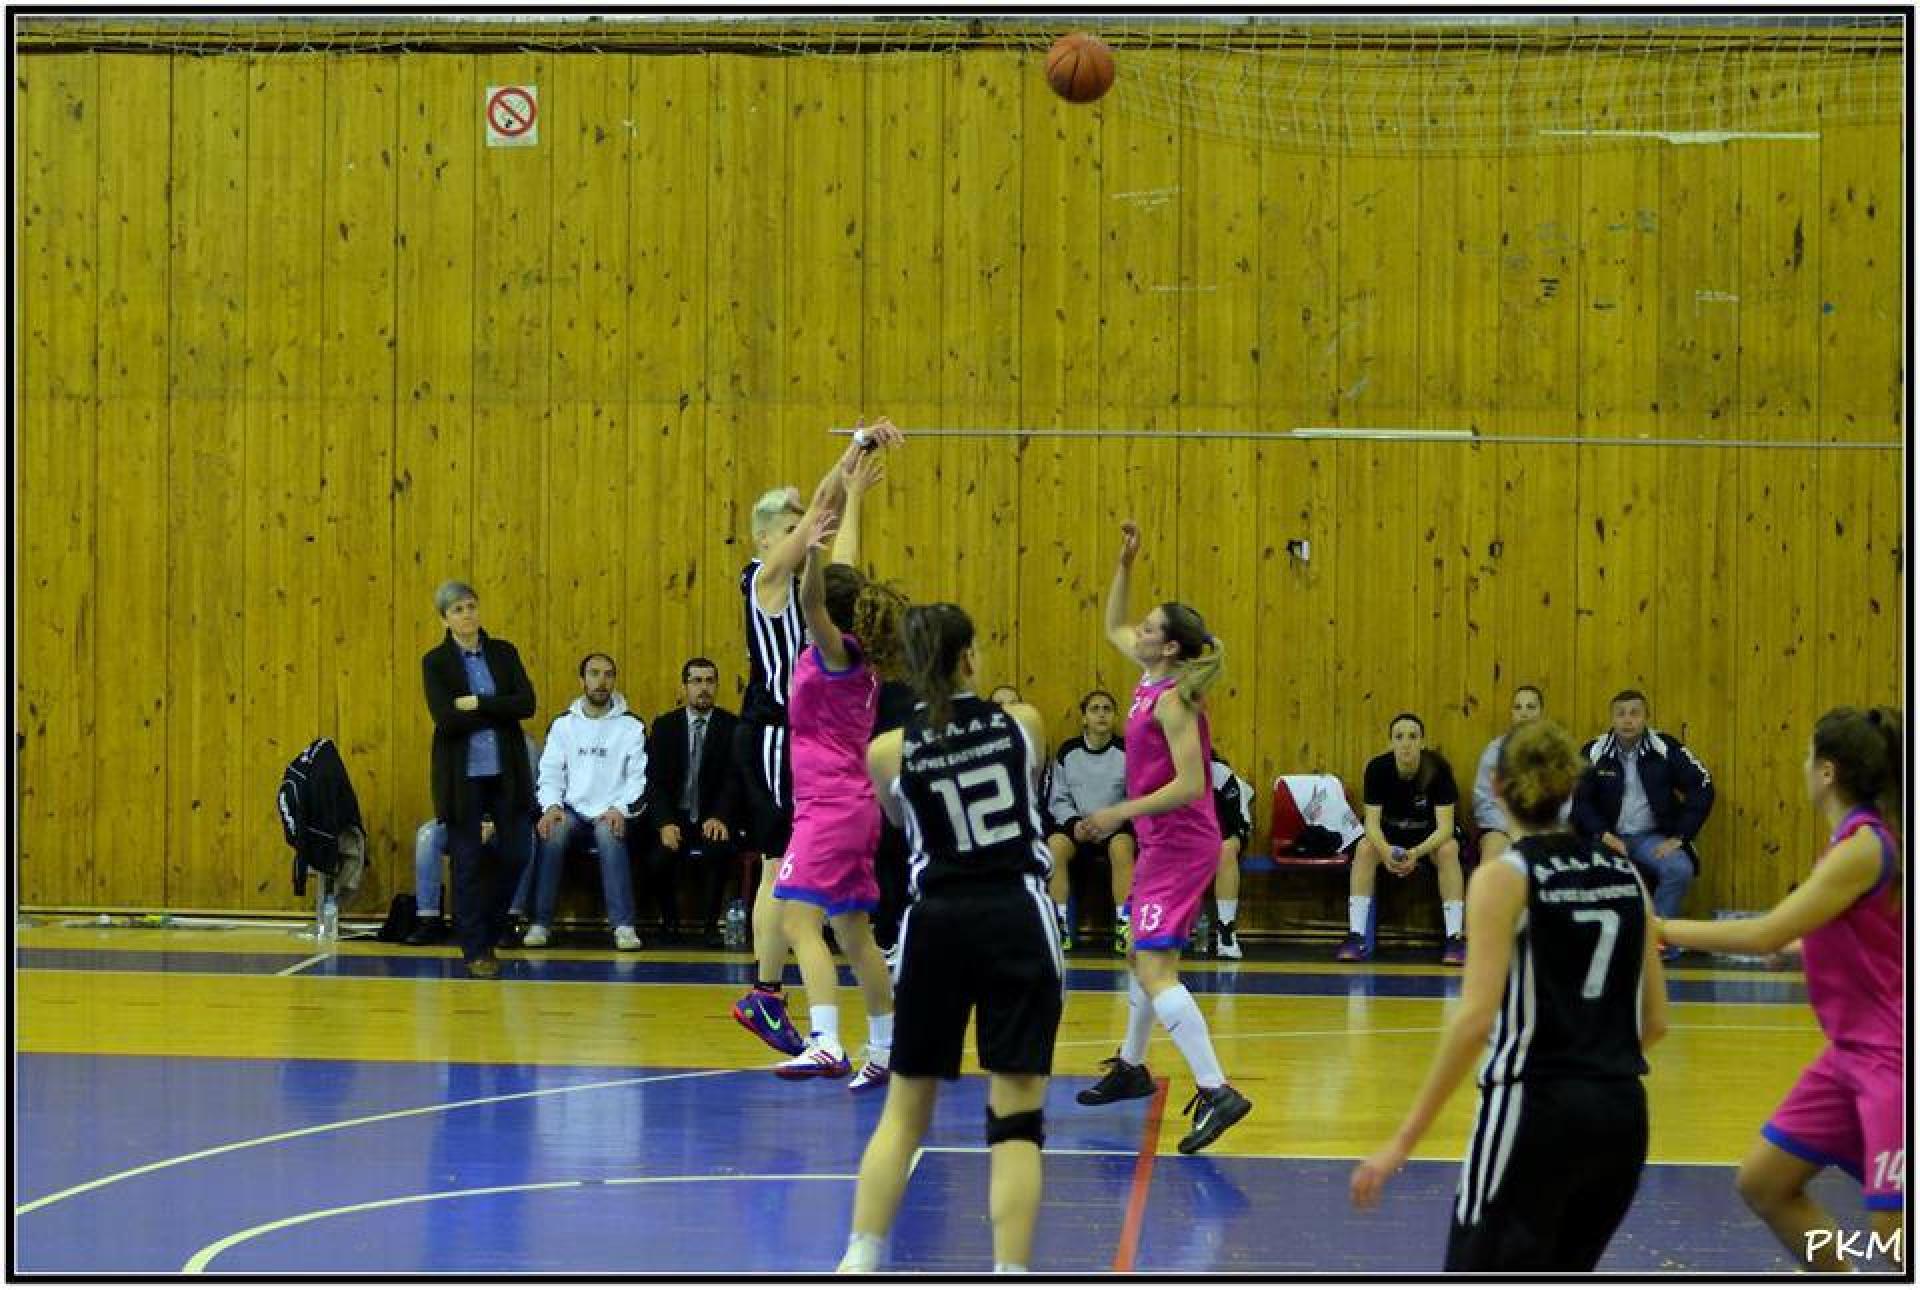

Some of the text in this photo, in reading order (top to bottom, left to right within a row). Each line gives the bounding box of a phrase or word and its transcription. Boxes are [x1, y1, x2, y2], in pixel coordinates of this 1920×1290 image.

[930, 764, 1021, 852] 12
[779, 853, 794, 881] 6
[1139, 903, 1163, 931] 13
[1573, 910, 1620, 998] 7
[1873, 1150, 1904, 1190] 14
